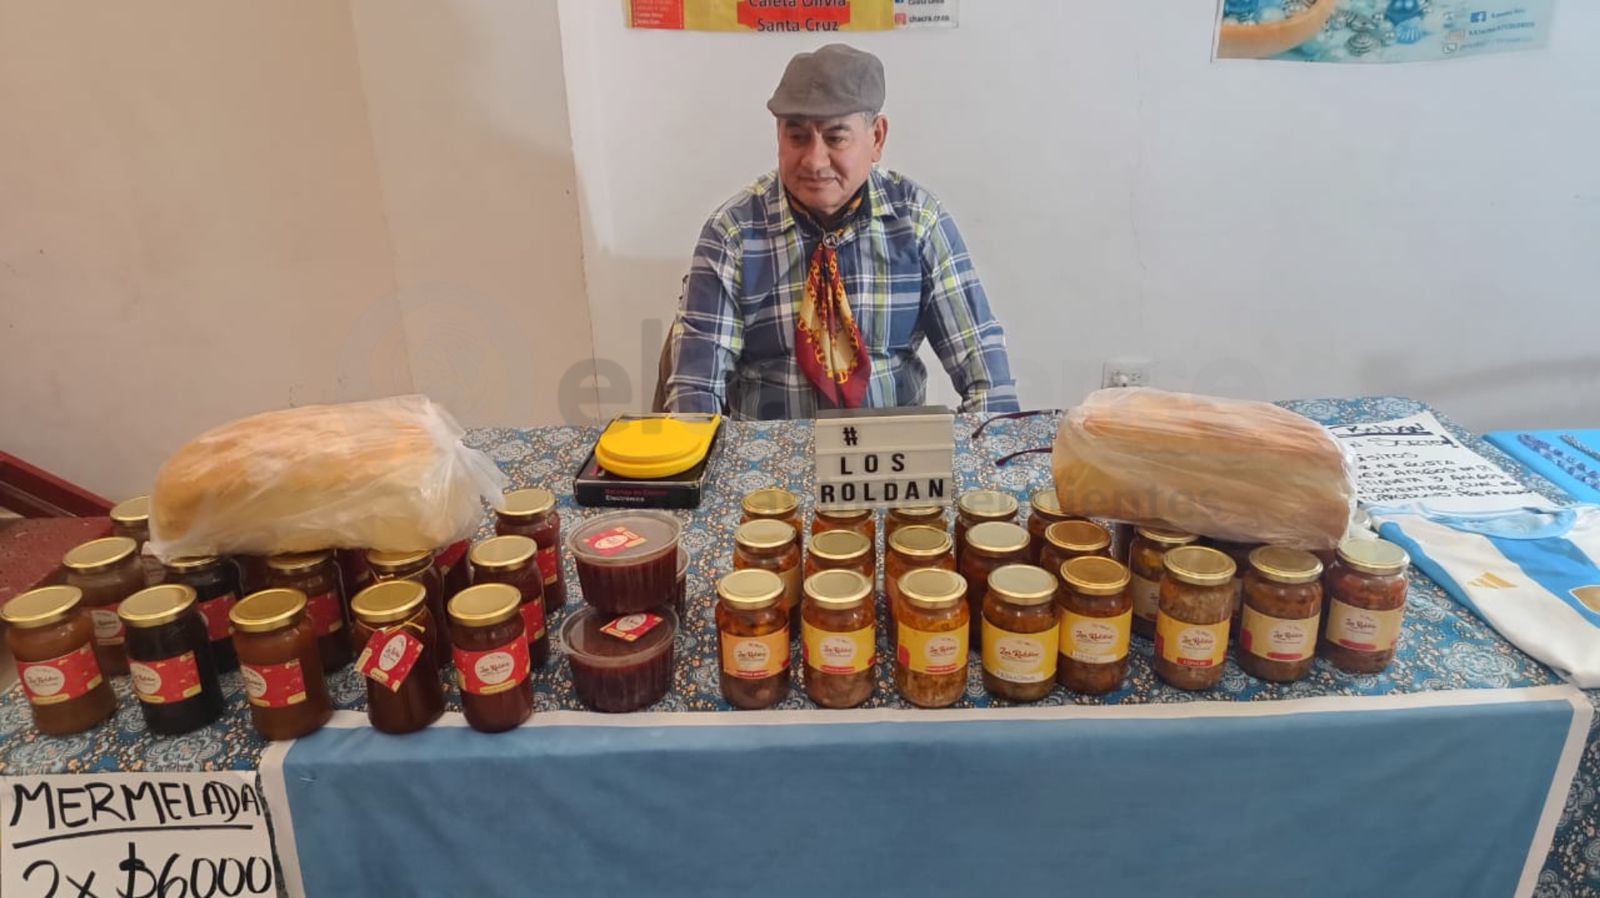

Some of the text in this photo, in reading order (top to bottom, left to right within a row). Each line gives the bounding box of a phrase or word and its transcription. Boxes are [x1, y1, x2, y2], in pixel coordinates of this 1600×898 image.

[757, 17, 839, 32] Santa Cruz
[842, 426, 858, 446] #
[840, 453, 905, 475] LOS
[820, 478, 944, 503] ROLDAN
[9, 781, 261, 829] MERMELADA
[116, 842, 272, 898] $6000
